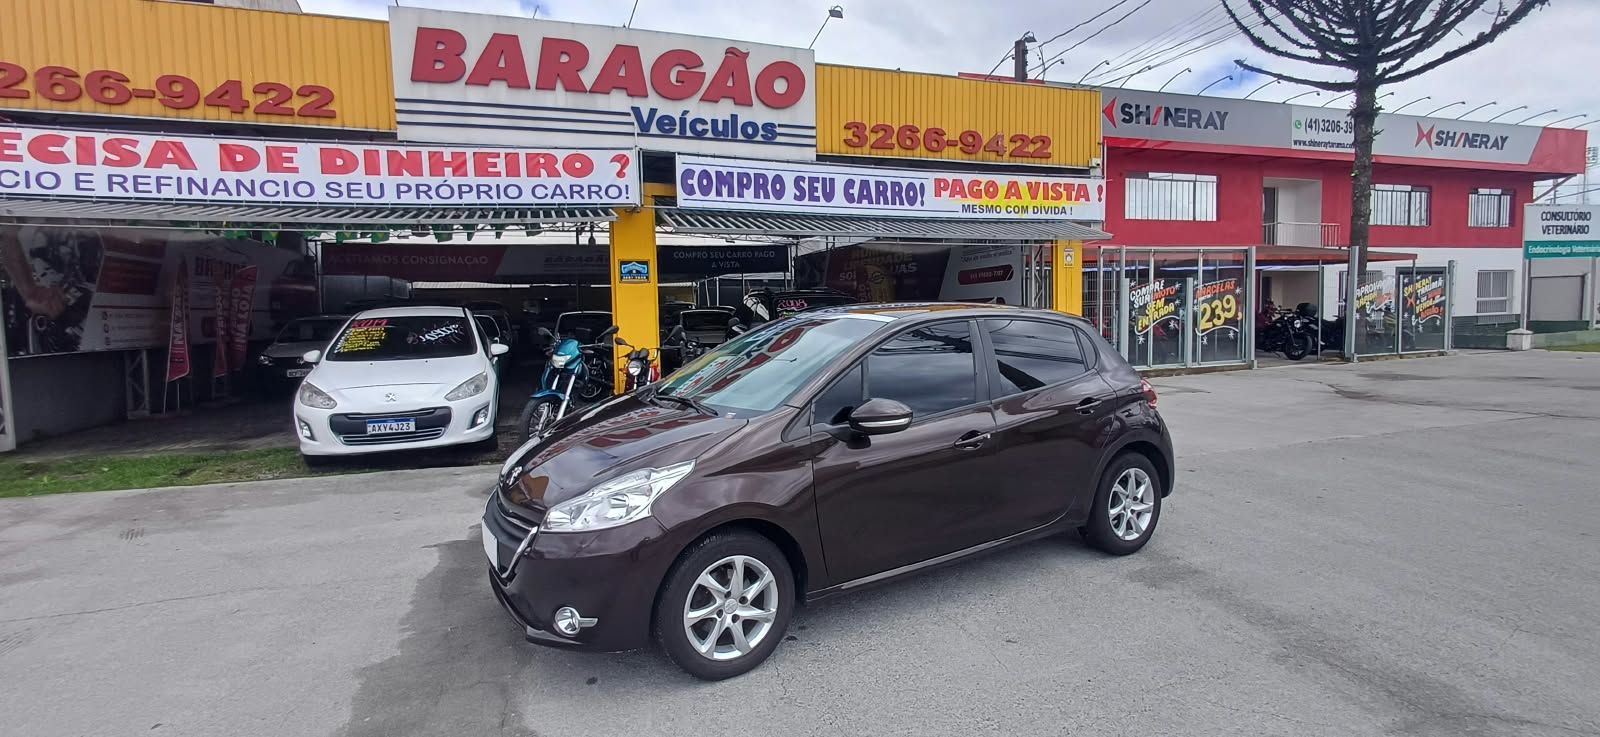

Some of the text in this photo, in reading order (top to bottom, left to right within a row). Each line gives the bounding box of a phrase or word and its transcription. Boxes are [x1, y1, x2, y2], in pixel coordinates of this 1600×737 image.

[409, 26, 807, 110] BARAGÃO
[0, 62, 337, 118] 266-9422
[631, 106, 779, 142] Veículos
[1120, 102, 1229, 131] SHINERAY
[843, 121, 1053, 159] 3266-9422
[1434, 129, 1509, 151] SHINERAY
[218, 143, 300, 173] DE
[319, 147, 594, 179] DINHEIRO
[609, 154, 630, 179] ?
[75, 172, 96, 192] E
[107, 174, 316, 199] REFINANCIO
[325, 181, 385, 199] SEU
[396, 179, 523, 201] PRÓPRIO
[531, 182, 630, 201] CARRO!
[680, 168, 926, 207] COMPRO SEU CARRO!
[933, 177, 1000, 201] PAGO
[1004, 181, 1023, 201] A
[1026, 182, 1091, 203] VISTA
[961, 203, 1001, 216] MESMO
[1004, 205, 1029, 216] COM
[1032, 204, 1068, 217] DÍVIDA
[1540, 208, 1592, 222] CONSULTÓRIO
[1541, 222, 1590, 235] VETERINÁRIO
[673, 250, 775, 259] COMPRO SEU CARRO PAGO
[1130, 280, 1165, 301] COMPRE
[371, 422, 411, 433] AXY4J23
